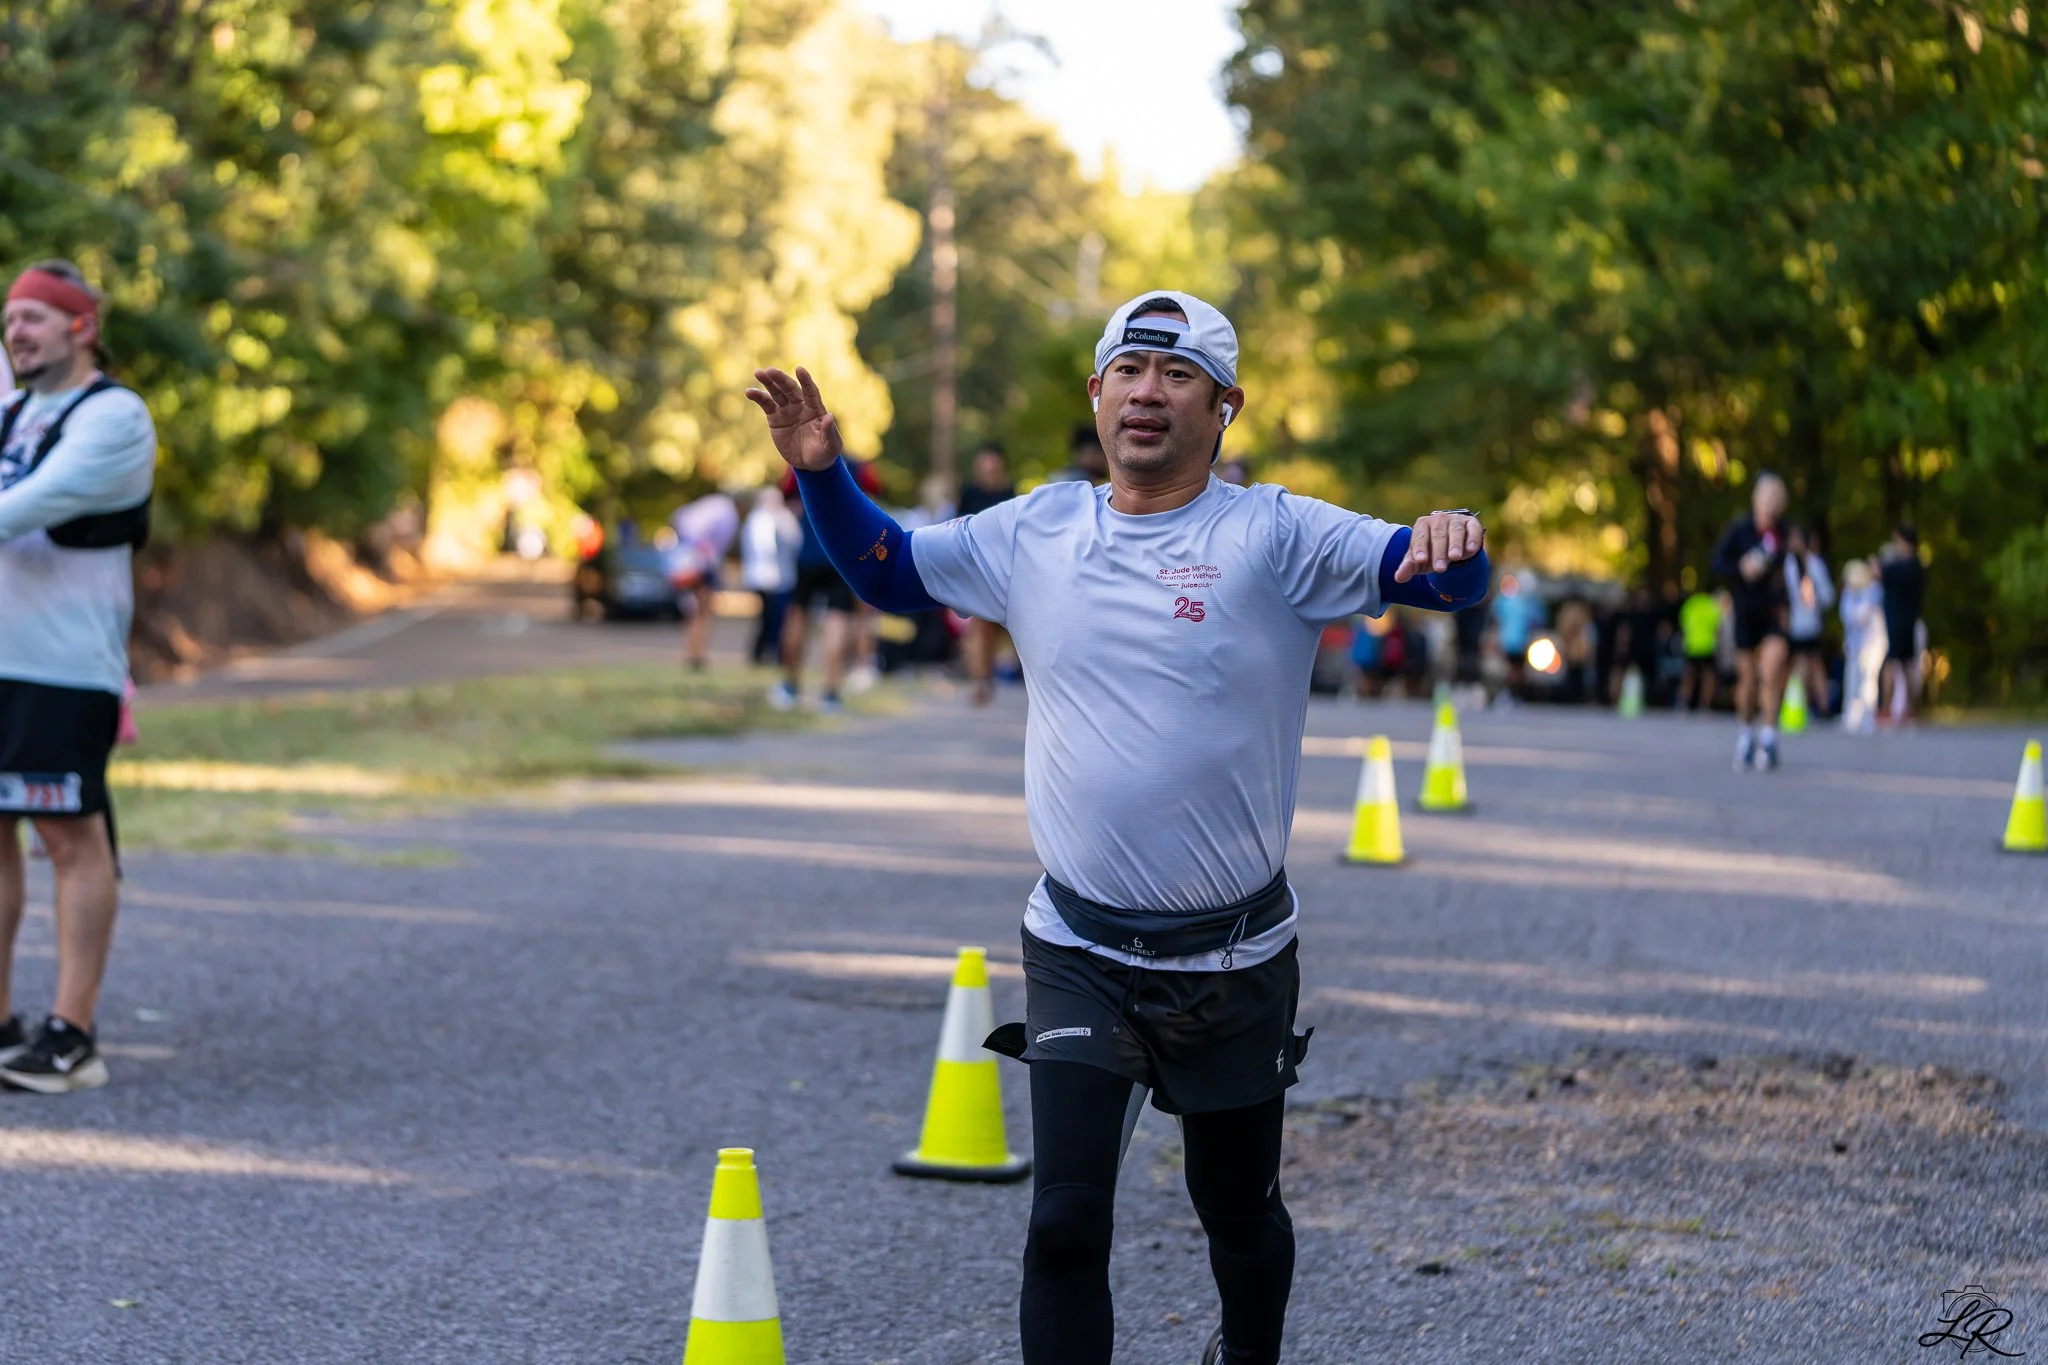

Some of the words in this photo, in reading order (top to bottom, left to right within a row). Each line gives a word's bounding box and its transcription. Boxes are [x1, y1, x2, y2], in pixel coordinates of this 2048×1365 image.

[1133, 331, 1168, 343] Columbia
[1173, 596, 1206, 622] 25
[1121, 944, 1157, 956] FLIPBELT
